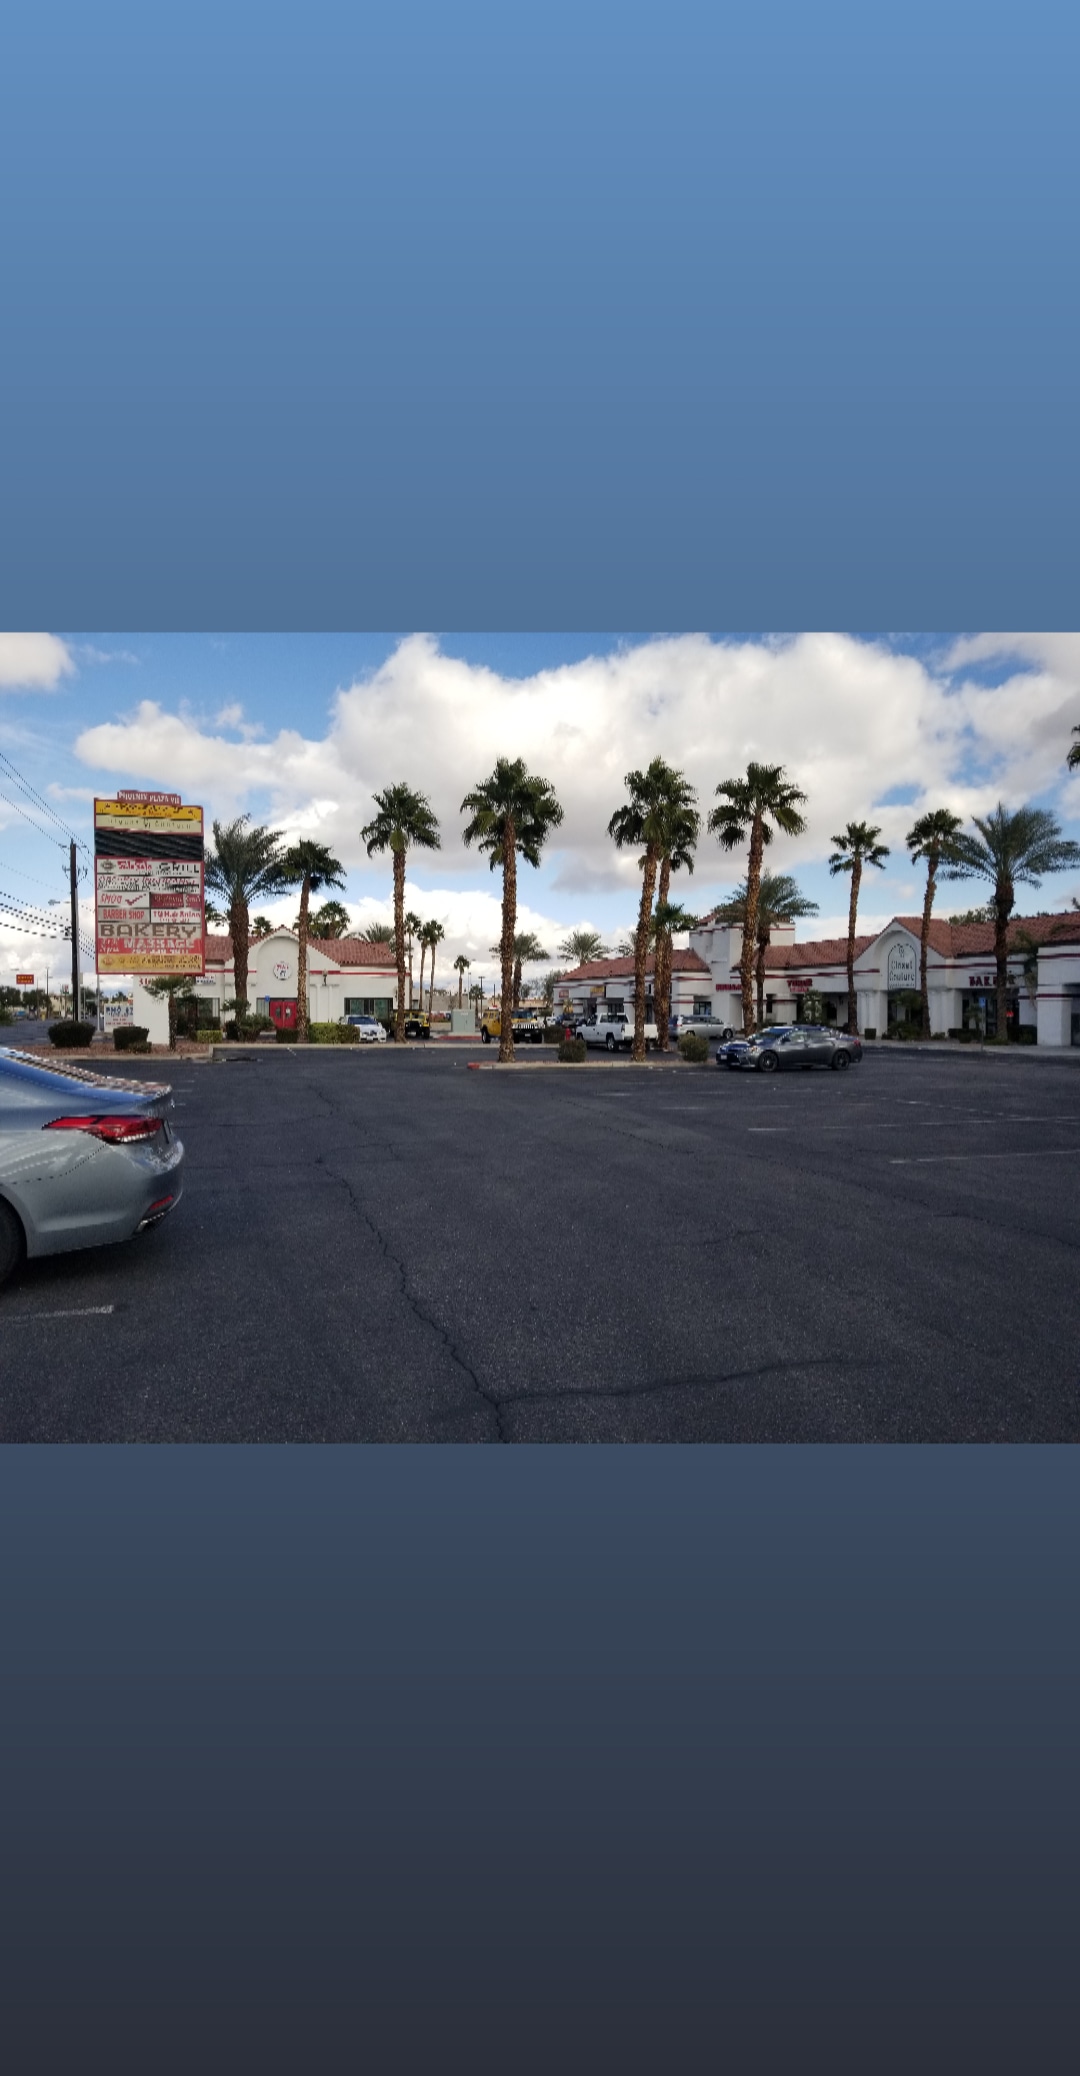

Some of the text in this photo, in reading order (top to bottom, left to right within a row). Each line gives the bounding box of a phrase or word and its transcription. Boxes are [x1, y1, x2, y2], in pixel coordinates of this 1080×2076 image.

[103, 909, 127, 919] BARBER
[128, 911, 145, 920] SHOP
[100, 923, 196, 939] BAKERY
[124, 938, 195, 949] MASSAGE
